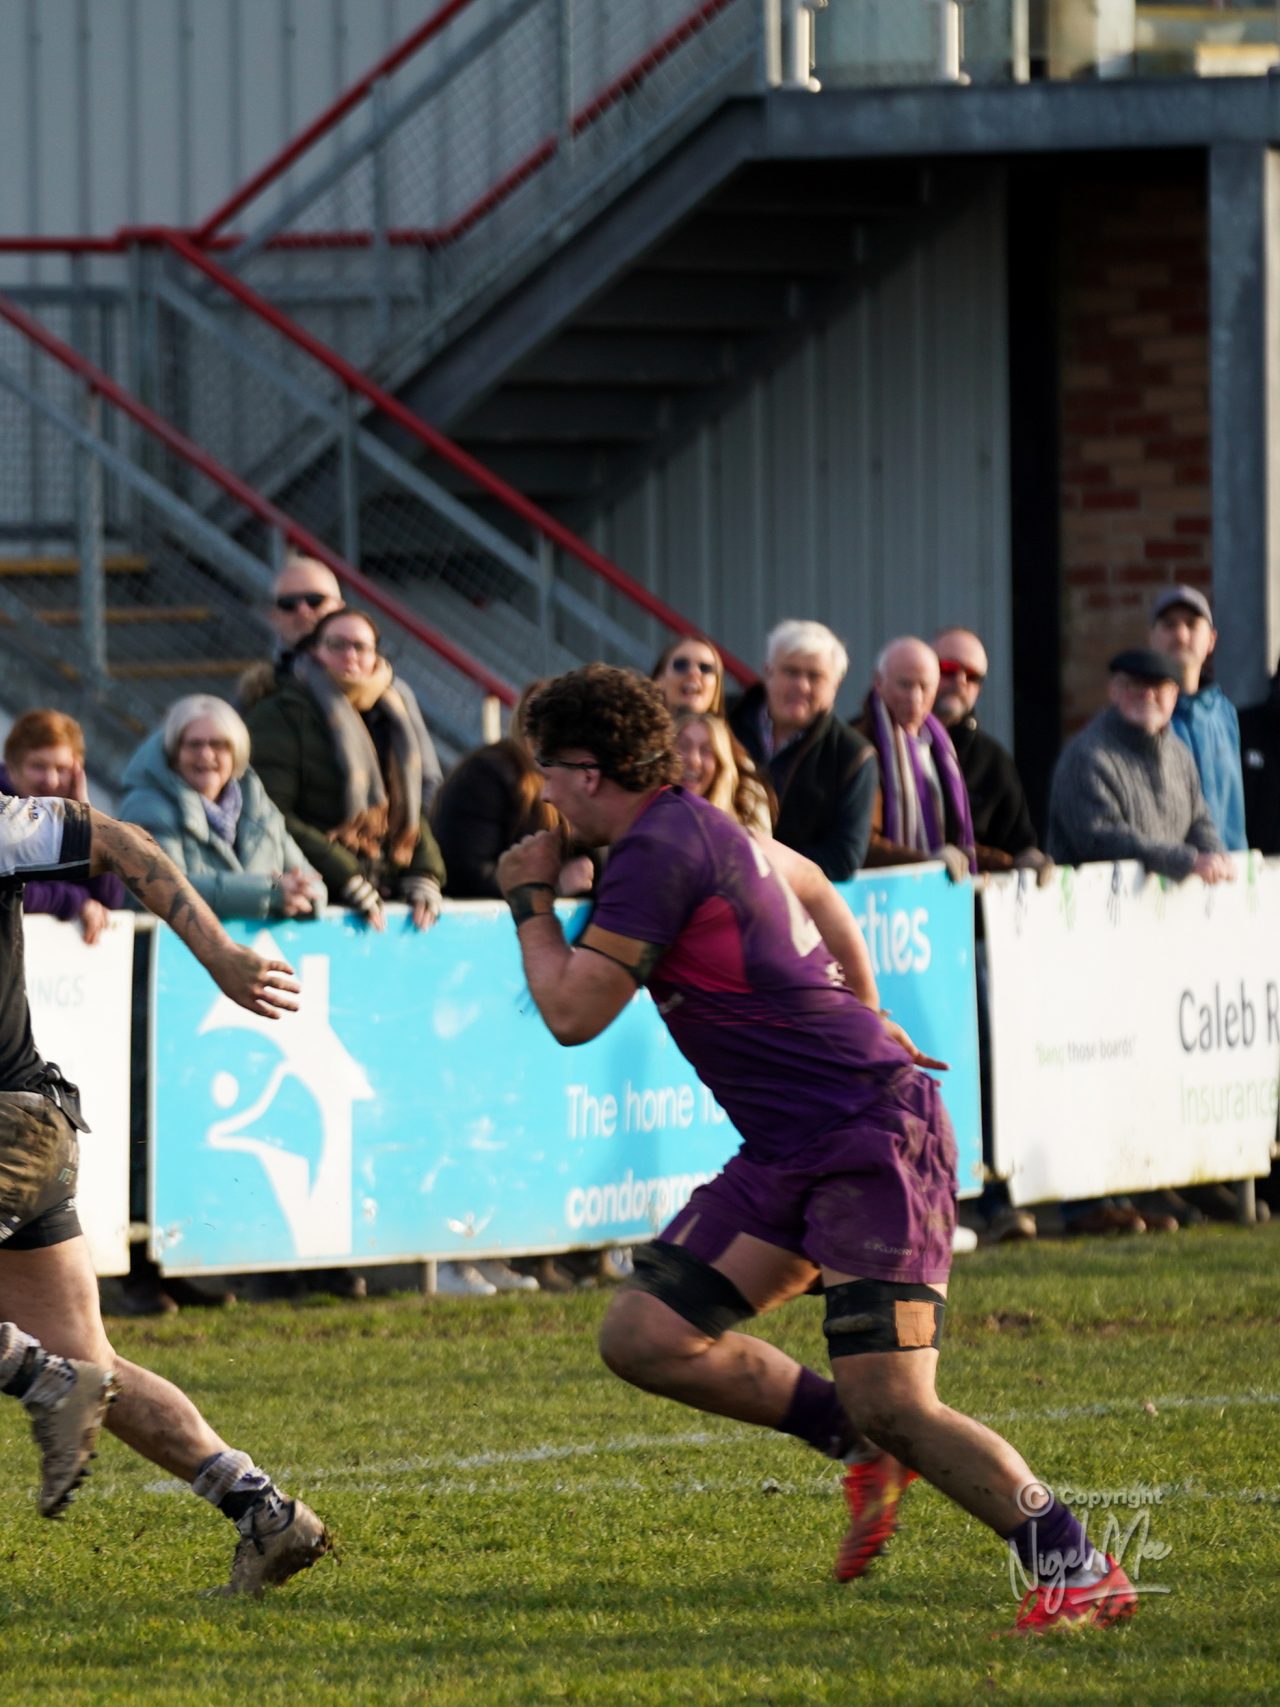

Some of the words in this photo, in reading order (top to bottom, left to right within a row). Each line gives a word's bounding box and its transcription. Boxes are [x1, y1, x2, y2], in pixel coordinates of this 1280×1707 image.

[1177, 978, 1256, 1054] Caleb
[1265, 980, 1280, 1045] R
[565, 1083, 618, 1138] The
[625, 1078, 694, 1133] home
[1178, 1072, 1280, 1127] Insurance
